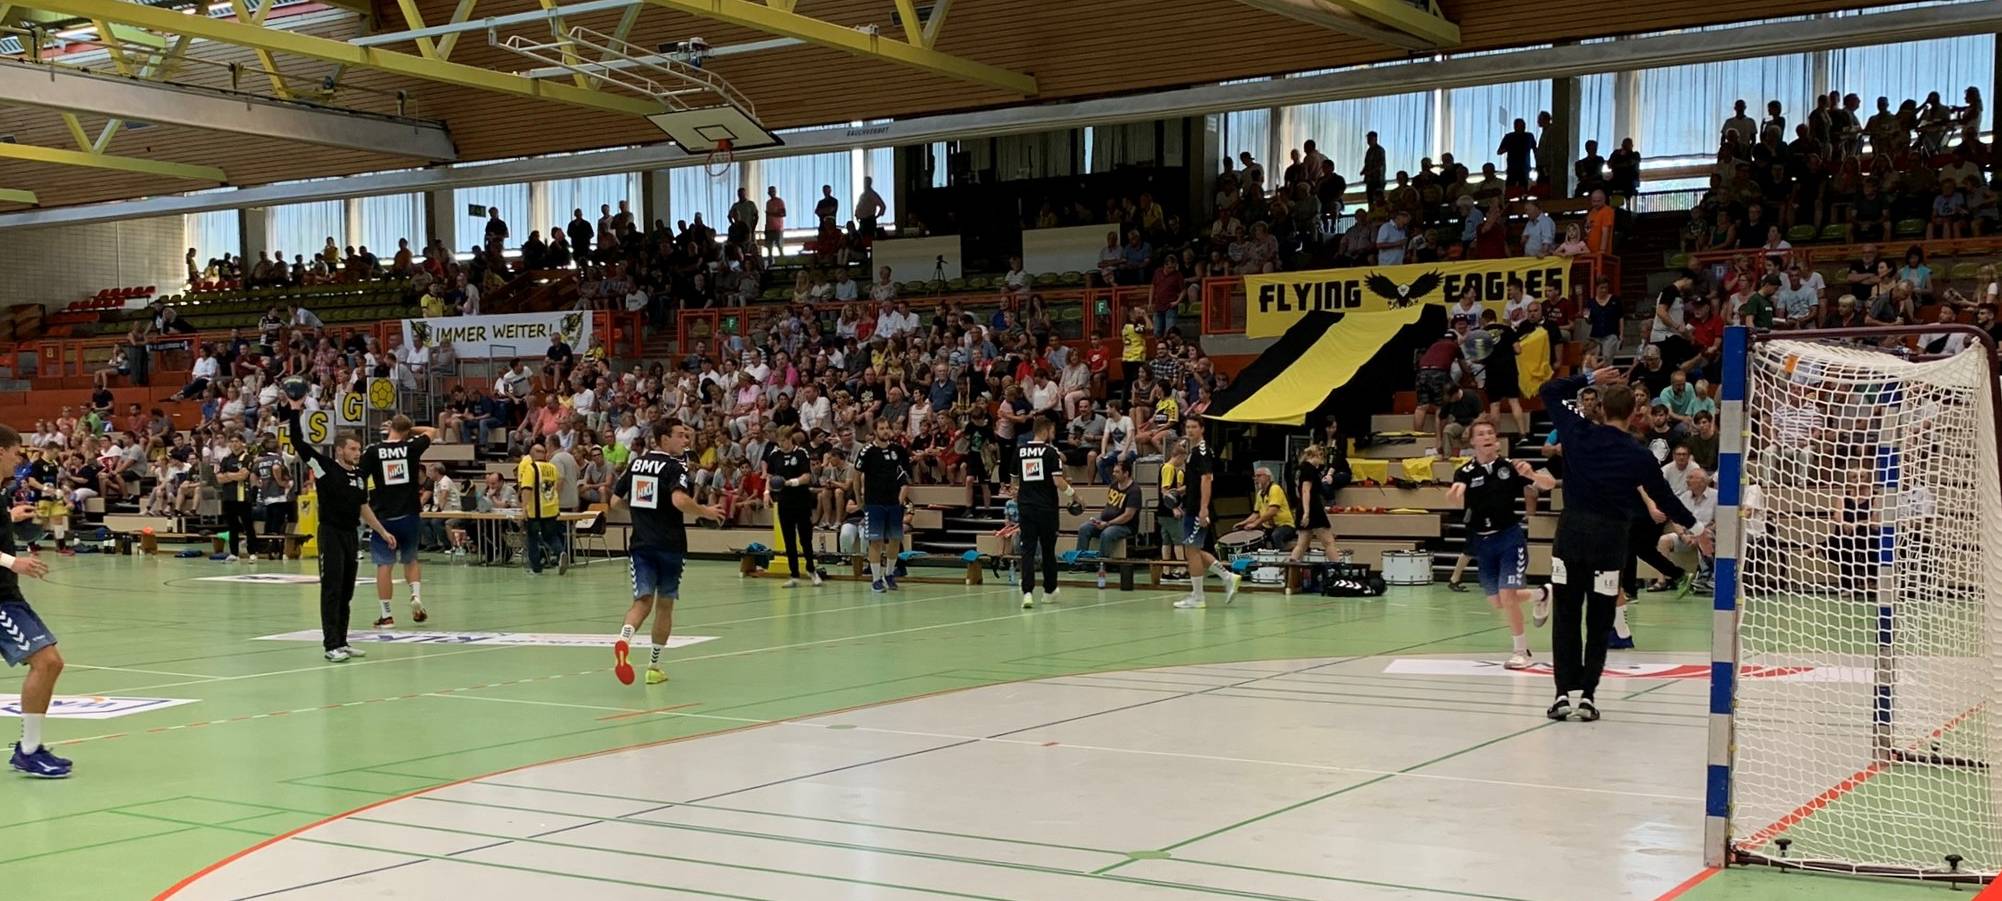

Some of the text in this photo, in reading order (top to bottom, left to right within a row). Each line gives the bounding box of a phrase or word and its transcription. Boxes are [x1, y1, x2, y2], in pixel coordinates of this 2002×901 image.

[1259, 280, 1362, 312] FLYING
[1098, 302, 1105, 313] F
[436, 327, 486, 342] IMMER
[308, 411, 328, 443] S
[342, 391, 363, 422] G
[378, 446, 408, 459] BMV
[1020, 447, 1046, 457] BMV
[631, 459, 666, 474] BMV
